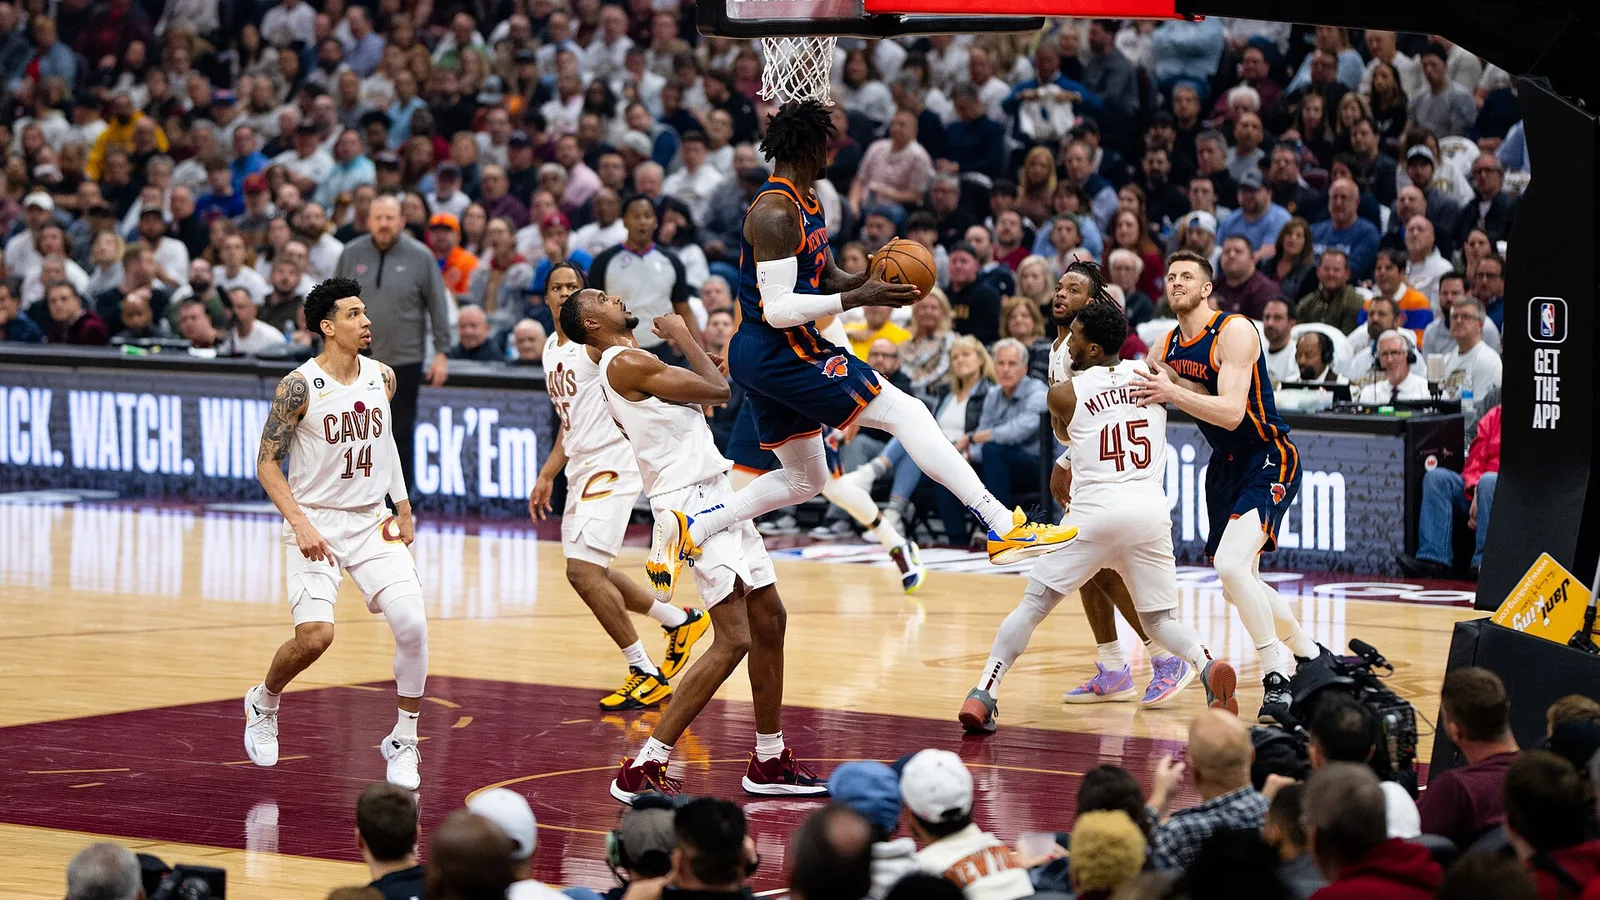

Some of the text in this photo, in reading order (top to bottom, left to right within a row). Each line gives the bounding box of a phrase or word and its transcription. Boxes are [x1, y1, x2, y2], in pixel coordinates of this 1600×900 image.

[810, 249, 827, 288] 3
[1534, 348, 1560, 374] GET
[1534, 376, 1560, 402] THE
[68, 389, 195, 475] WATCH.
[323, 406, 383, 445] CAVS
[1532, 403, 1560, 429] APP
[341, 444, 372, 479] 14
[414, 406, 537, 500] ck'Em
[1100, 419, 1151, 472] 45
[1541, 577, 1570, 622] Jani
